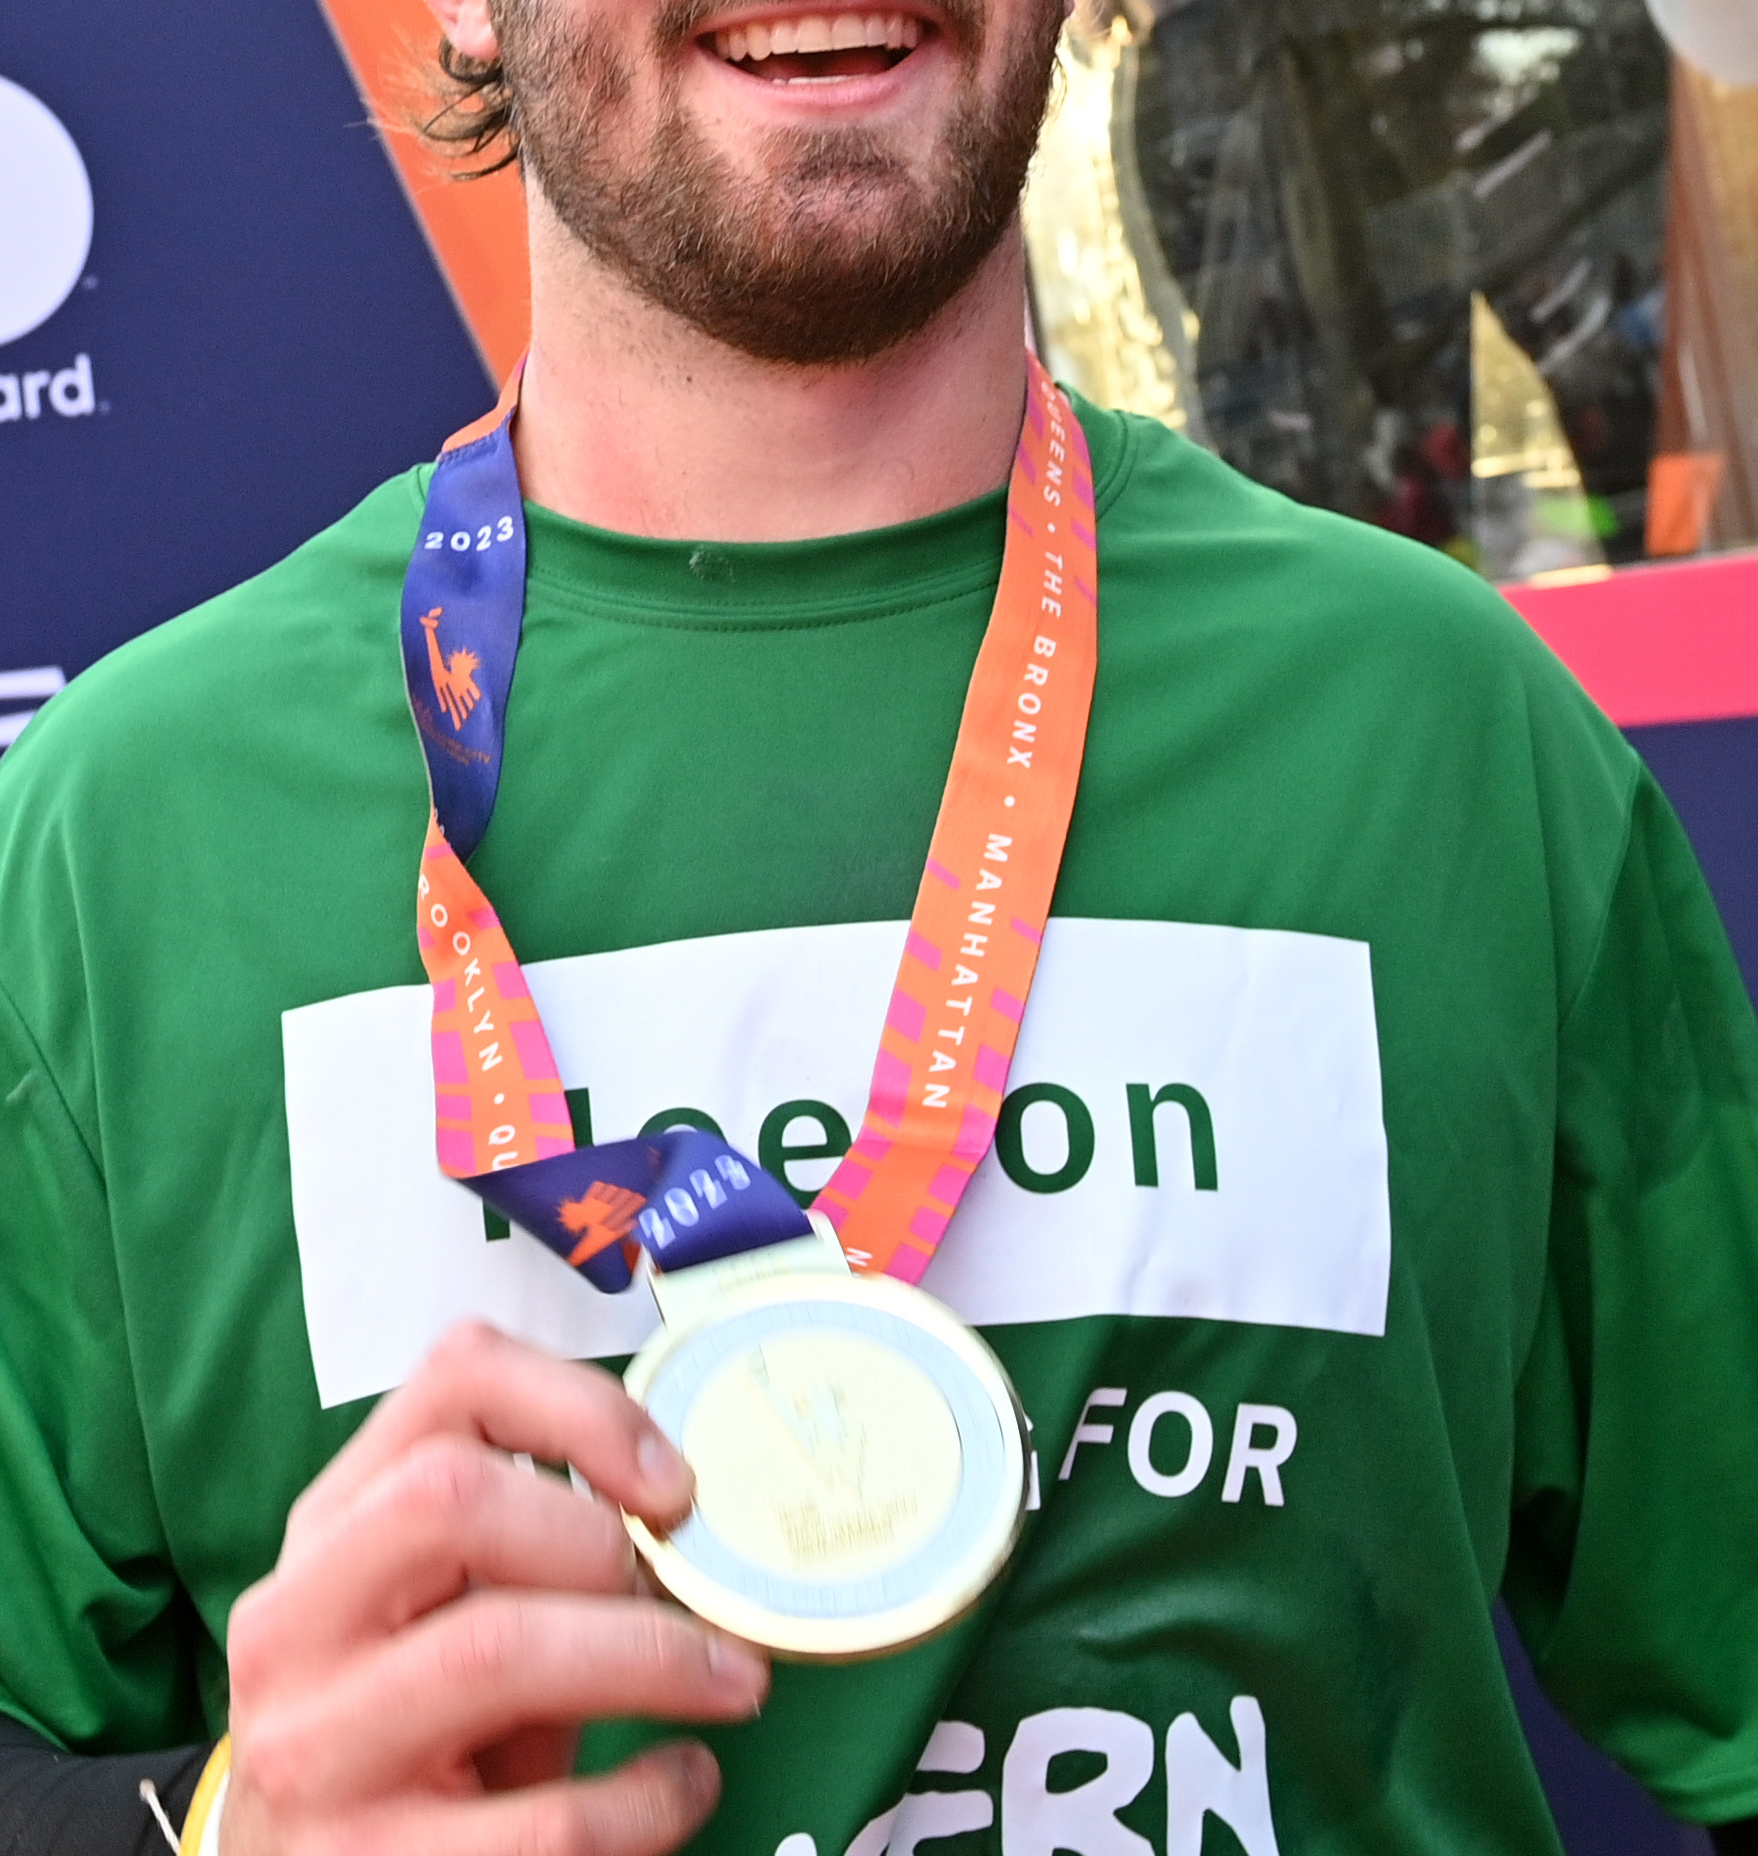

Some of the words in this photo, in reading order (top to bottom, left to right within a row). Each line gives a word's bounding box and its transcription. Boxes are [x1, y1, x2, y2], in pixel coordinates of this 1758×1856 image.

[424, 515, 515, 551] 2023
[1040, 549, 1064, 620] THE
[1006, 633, 1057, 770] BRONX
[418, 873, 504, 1072] ROOKLYN
[922, 832, 1013, 1109] MANHATTAN
[1057, 1386, 1298, 1507] FOR
